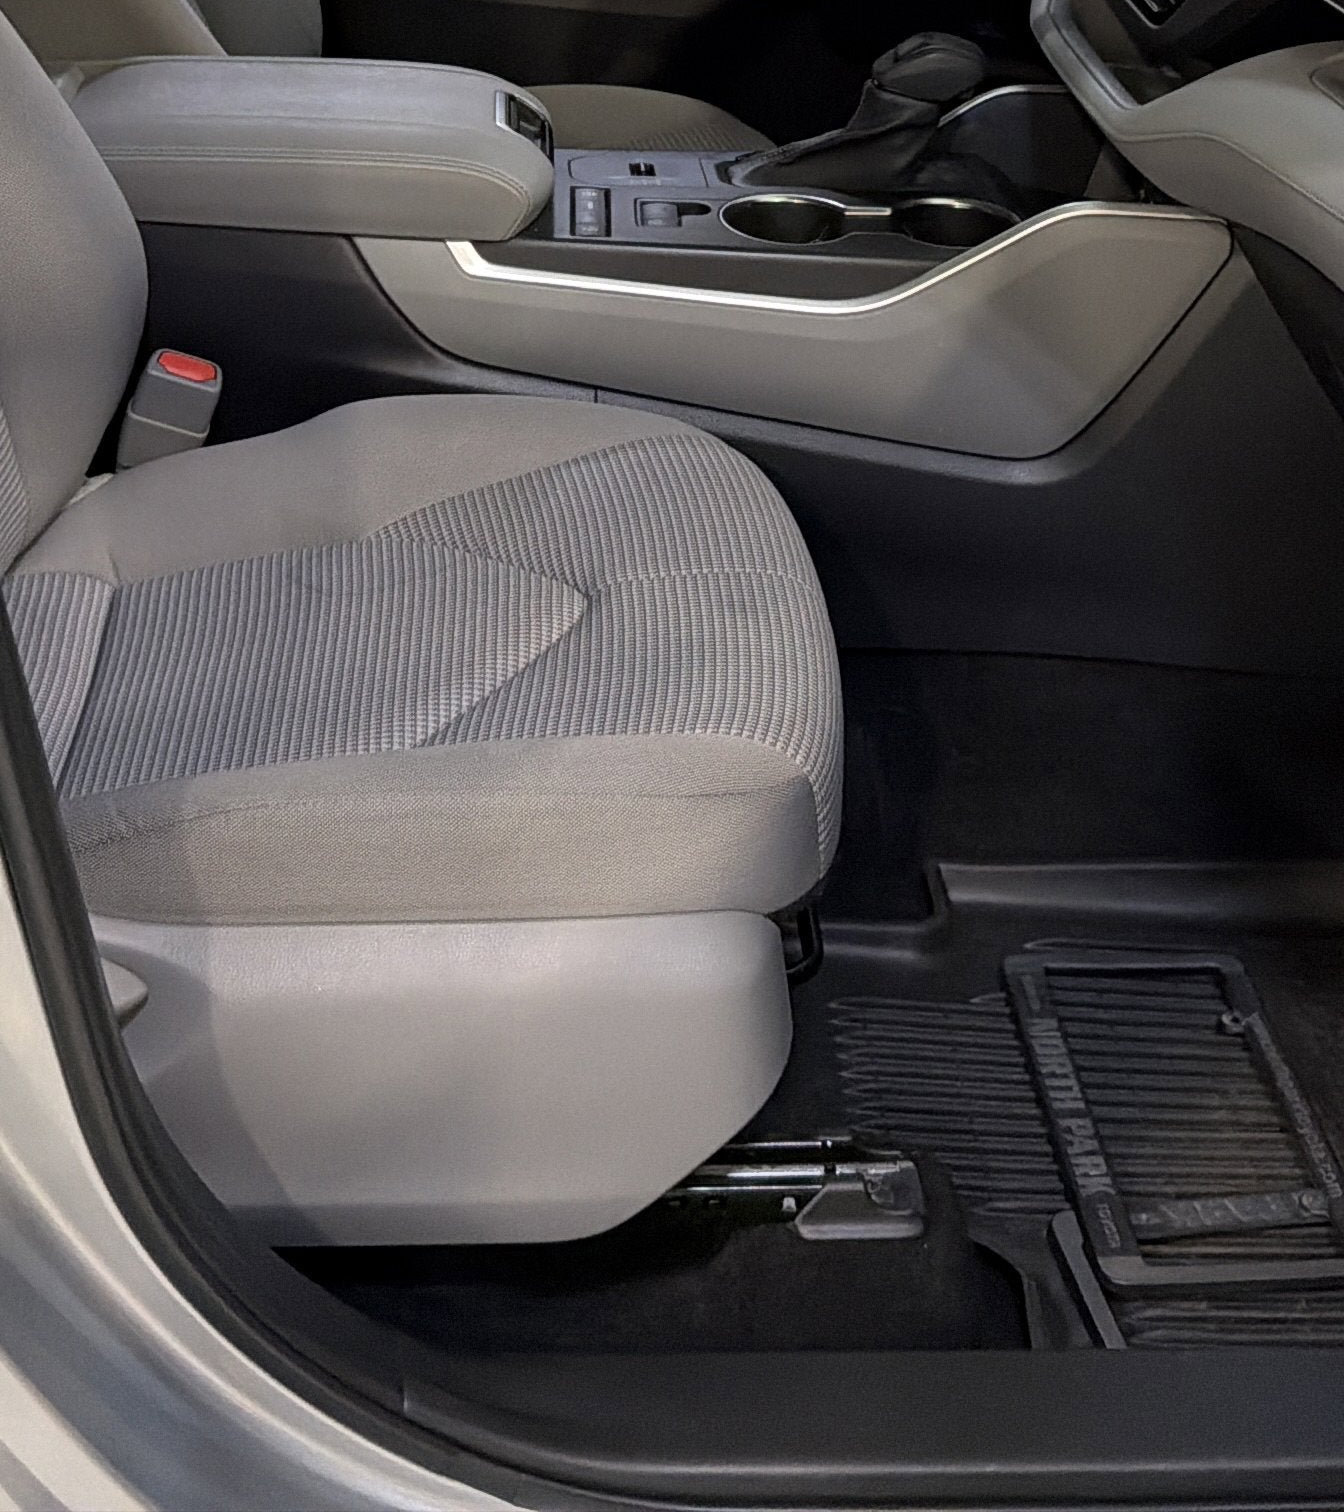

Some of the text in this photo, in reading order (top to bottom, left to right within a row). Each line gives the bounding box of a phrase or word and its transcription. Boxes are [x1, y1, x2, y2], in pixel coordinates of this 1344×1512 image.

[1027, 1017, 1122, 1249] NORTH PARK TOYOTA
